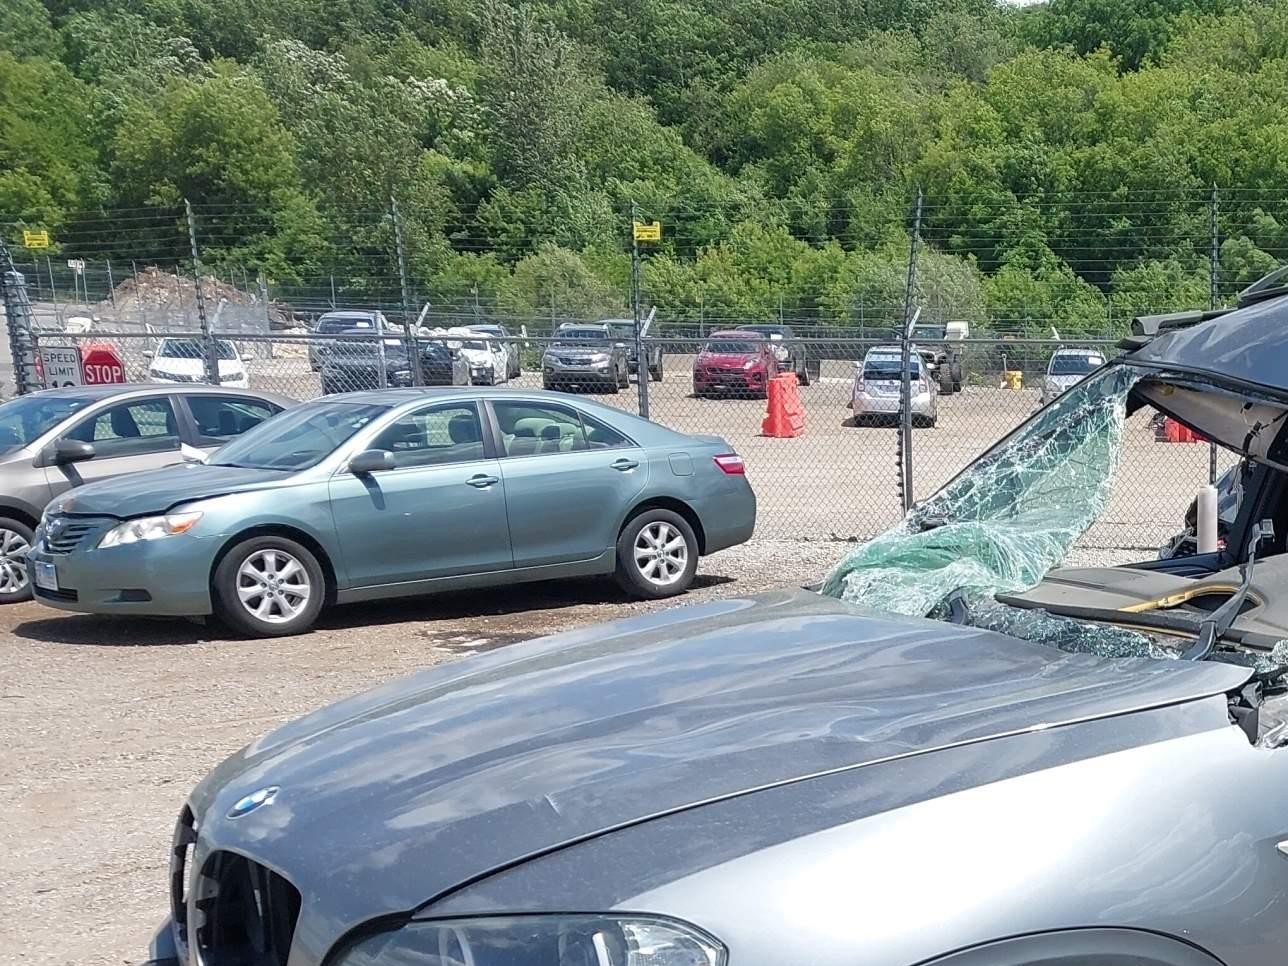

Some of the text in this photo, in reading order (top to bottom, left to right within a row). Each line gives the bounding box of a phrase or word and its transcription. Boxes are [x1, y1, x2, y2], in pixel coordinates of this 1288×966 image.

[43, 353, 76, 363] SPEED
[48, 367, 75, 376] LIMIT
[85, 364, 121, 383] STOP
